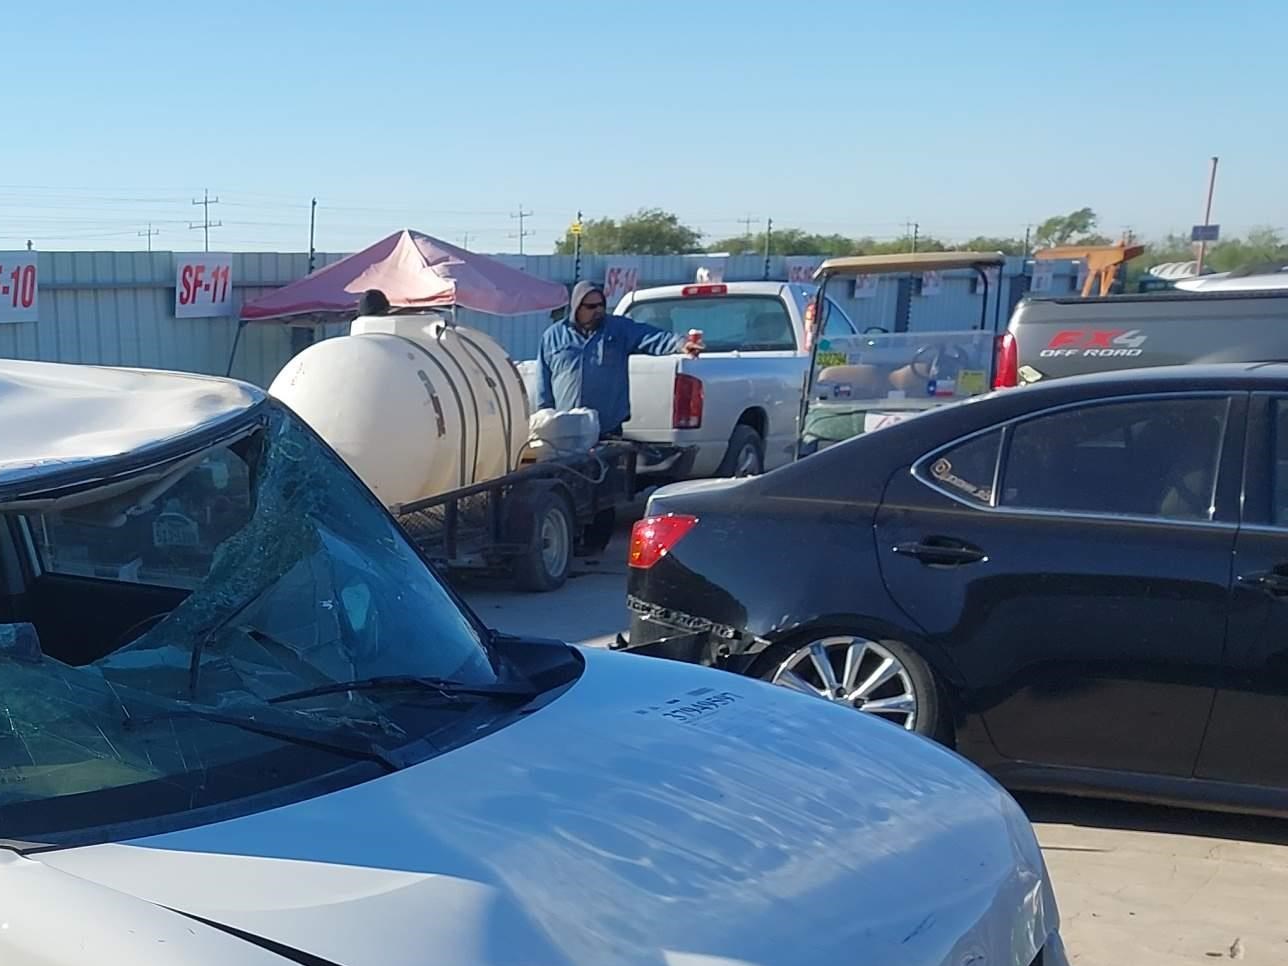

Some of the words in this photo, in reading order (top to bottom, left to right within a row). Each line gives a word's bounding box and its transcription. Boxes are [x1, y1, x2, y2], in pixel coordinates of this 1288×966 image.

[179, 264, 230, 305] SF-11
[1048, 329, 1148, 350] FX4
[1039, 348, 1080, 357] OFF
[1082, 348, 1143, 357] ROAD
